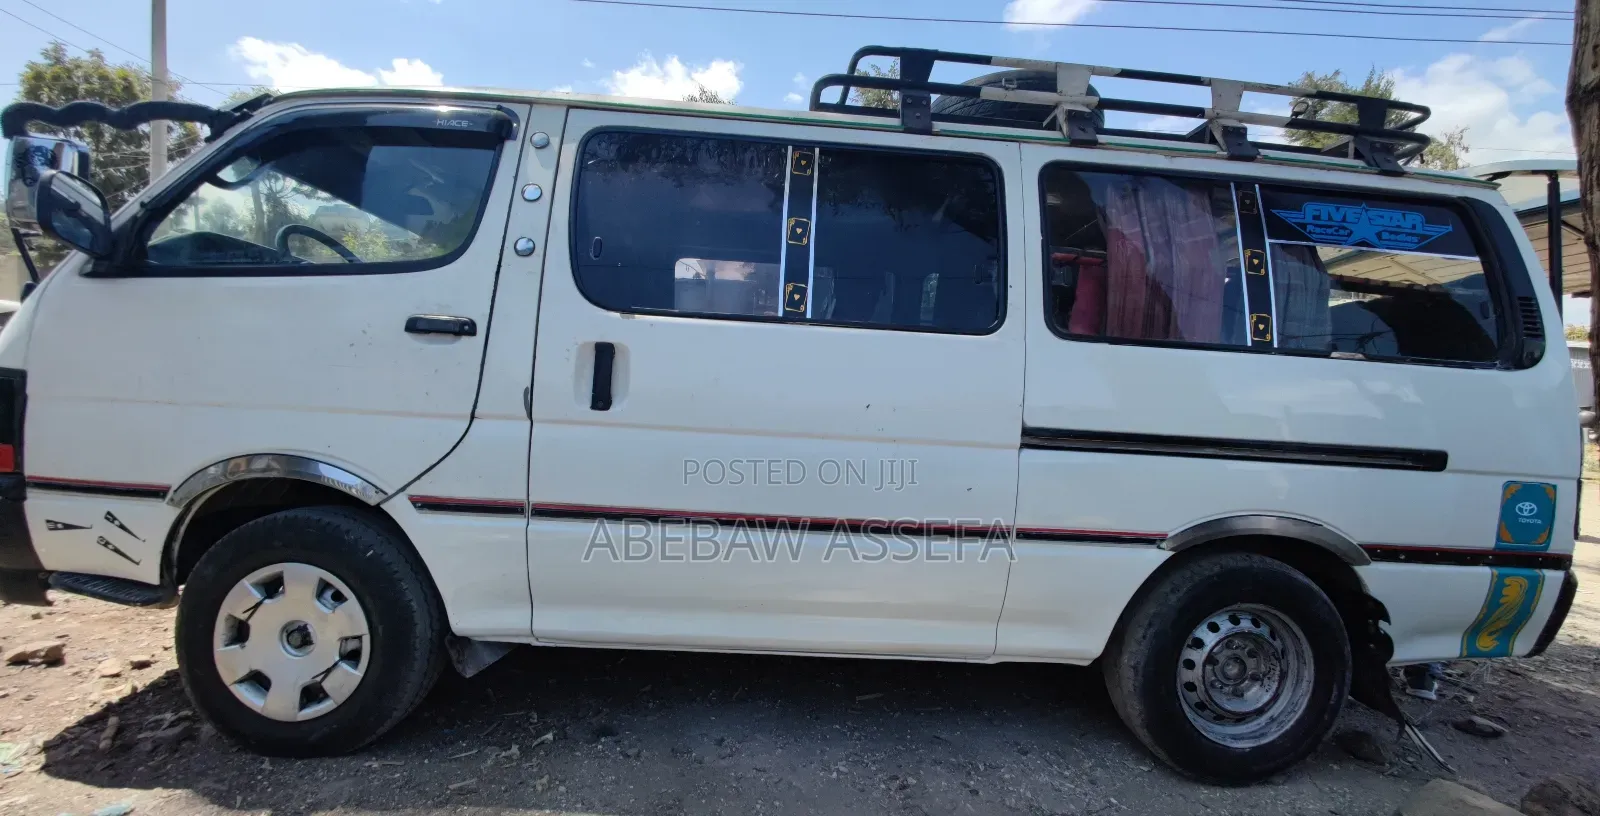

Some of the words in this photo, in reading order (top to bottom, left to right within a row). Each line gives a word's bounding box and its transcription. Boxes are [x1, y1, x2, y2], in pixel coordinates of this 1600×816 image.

[436, 119, 468, 127] HIACE
[1304, 204, 1360, 224] FIVE
[1366, 210, 1422, 232] STAR
